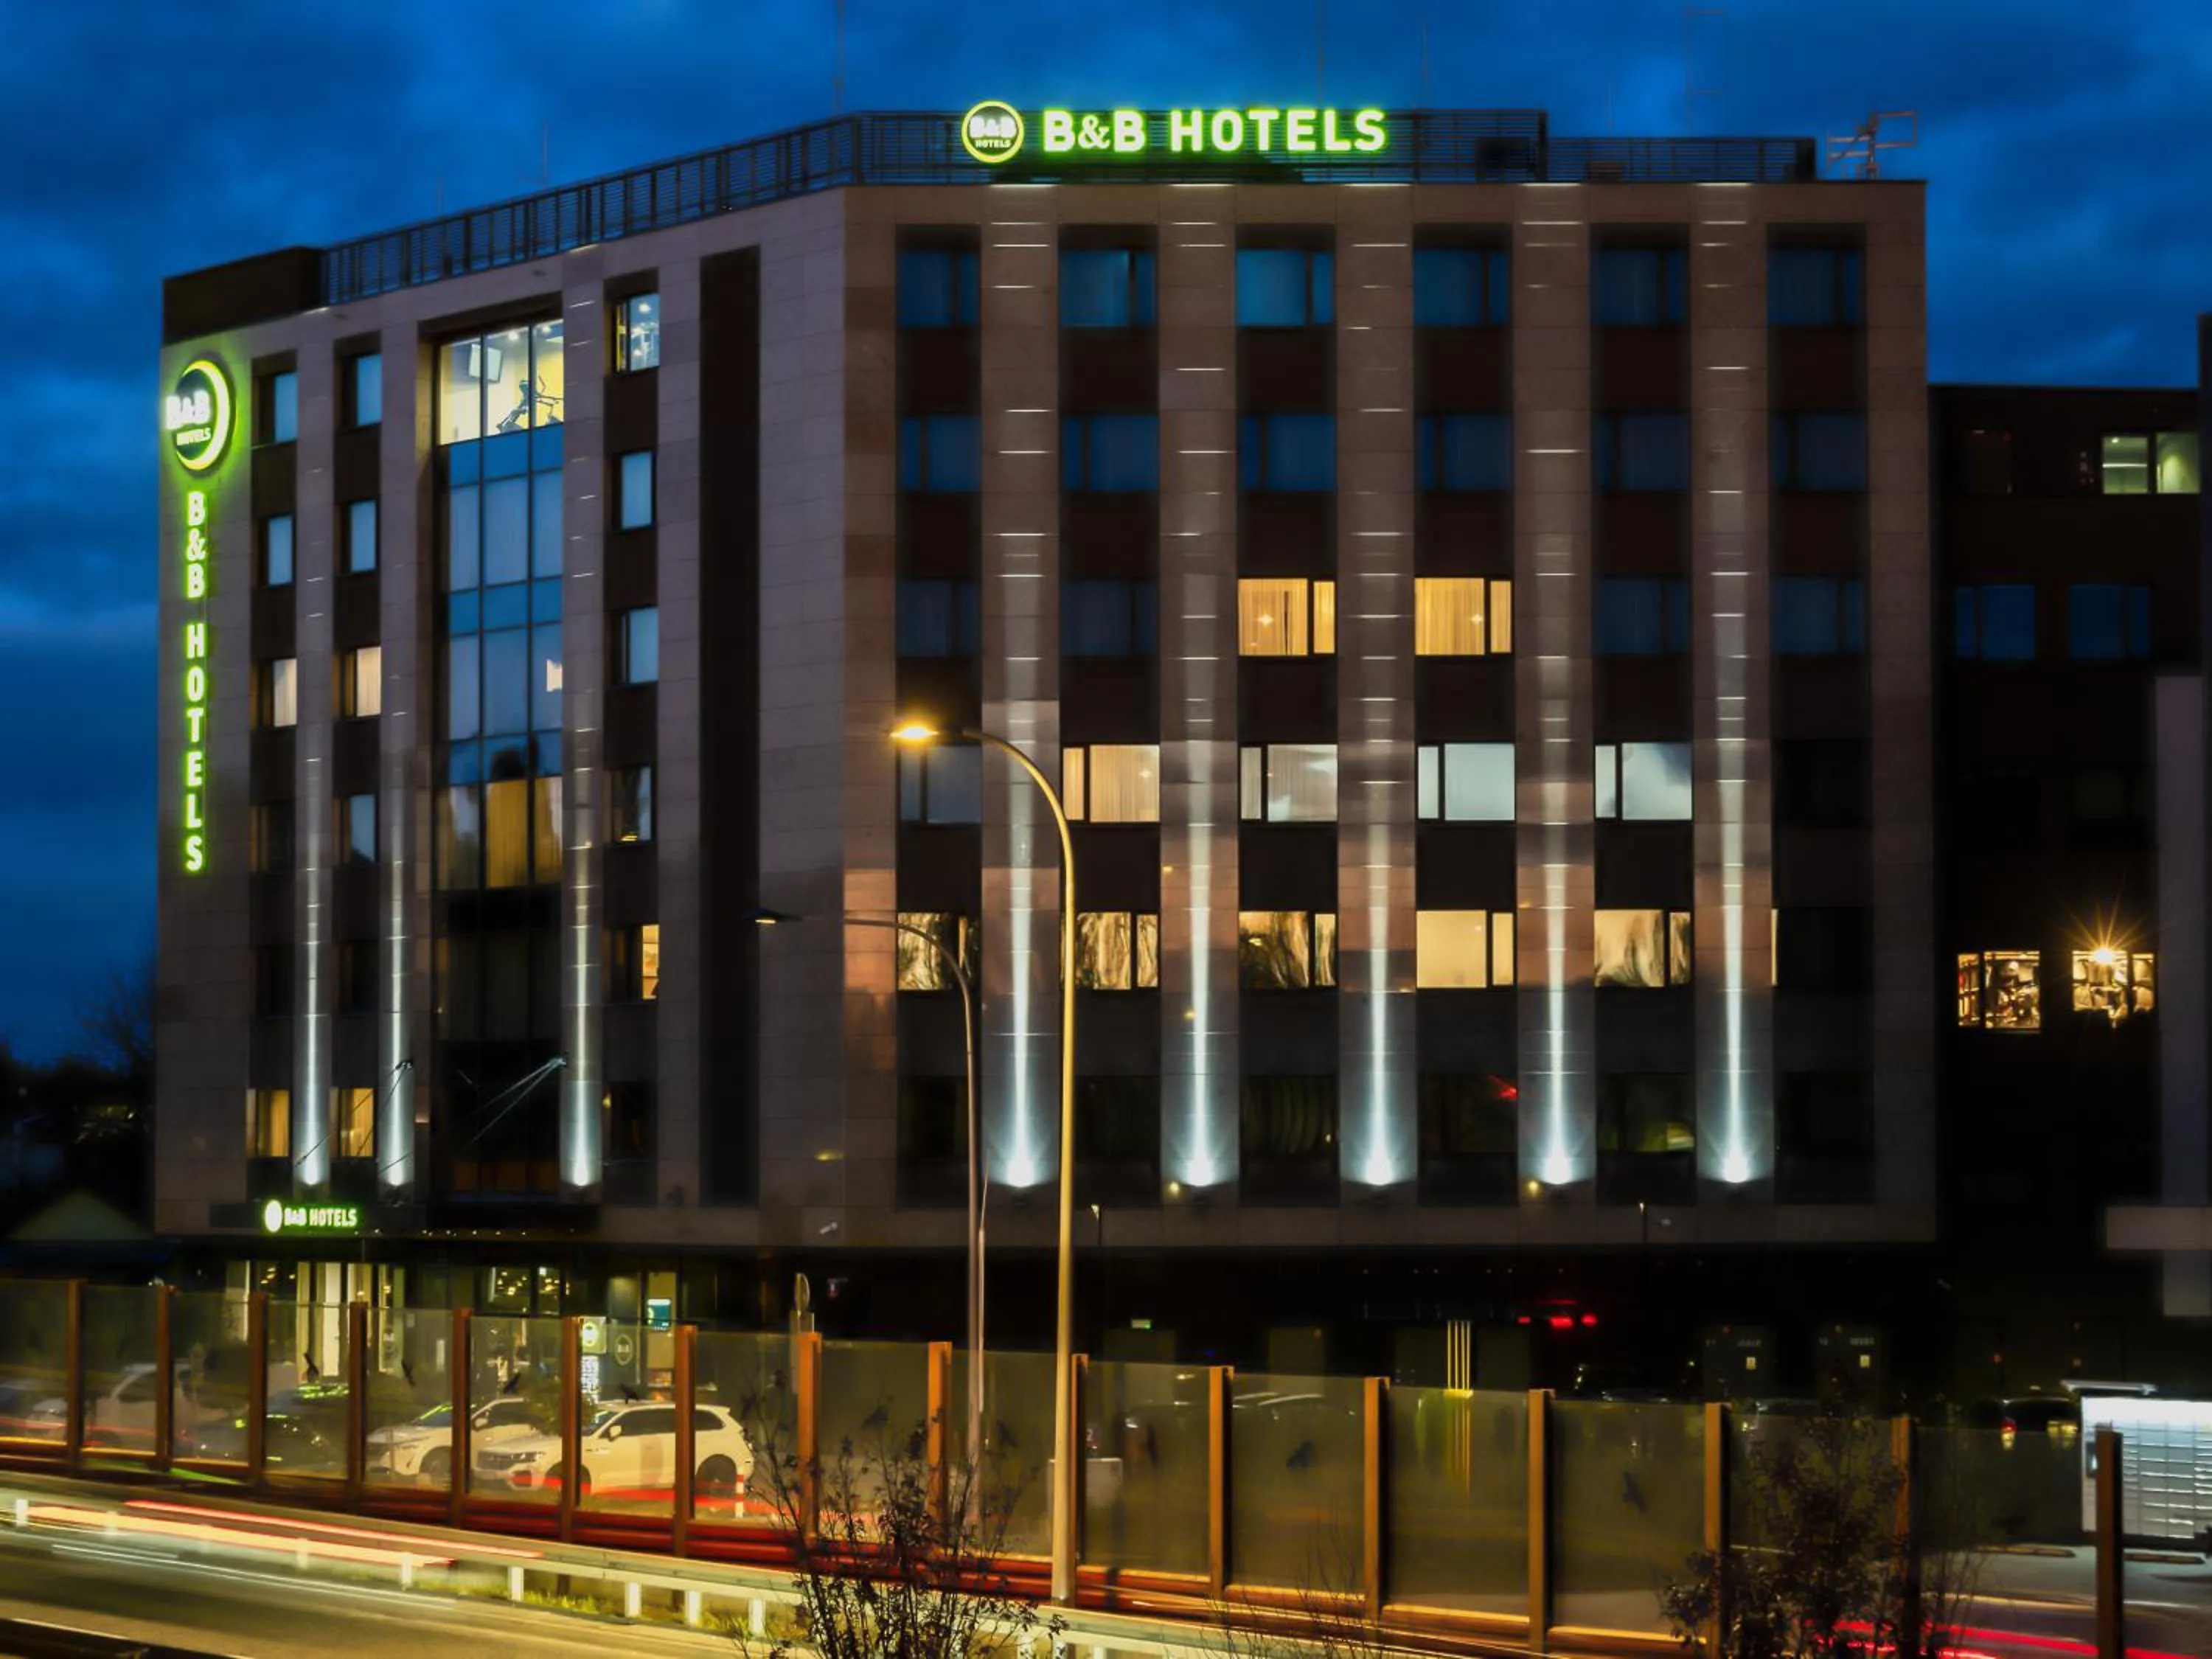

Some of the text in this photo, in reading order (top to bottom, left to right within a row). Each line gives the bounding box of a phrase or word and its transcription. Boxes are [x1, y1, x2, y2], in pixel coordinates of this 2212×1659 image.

[1043, 109, 1385, 152] B&B HOTELS
[176, 427, 212, 446] TELS
[187, 491, 207, 599] B&B
[186, 623, 205, 873] HOTELS
[309, 1208, 358, 1228] HOTELS
